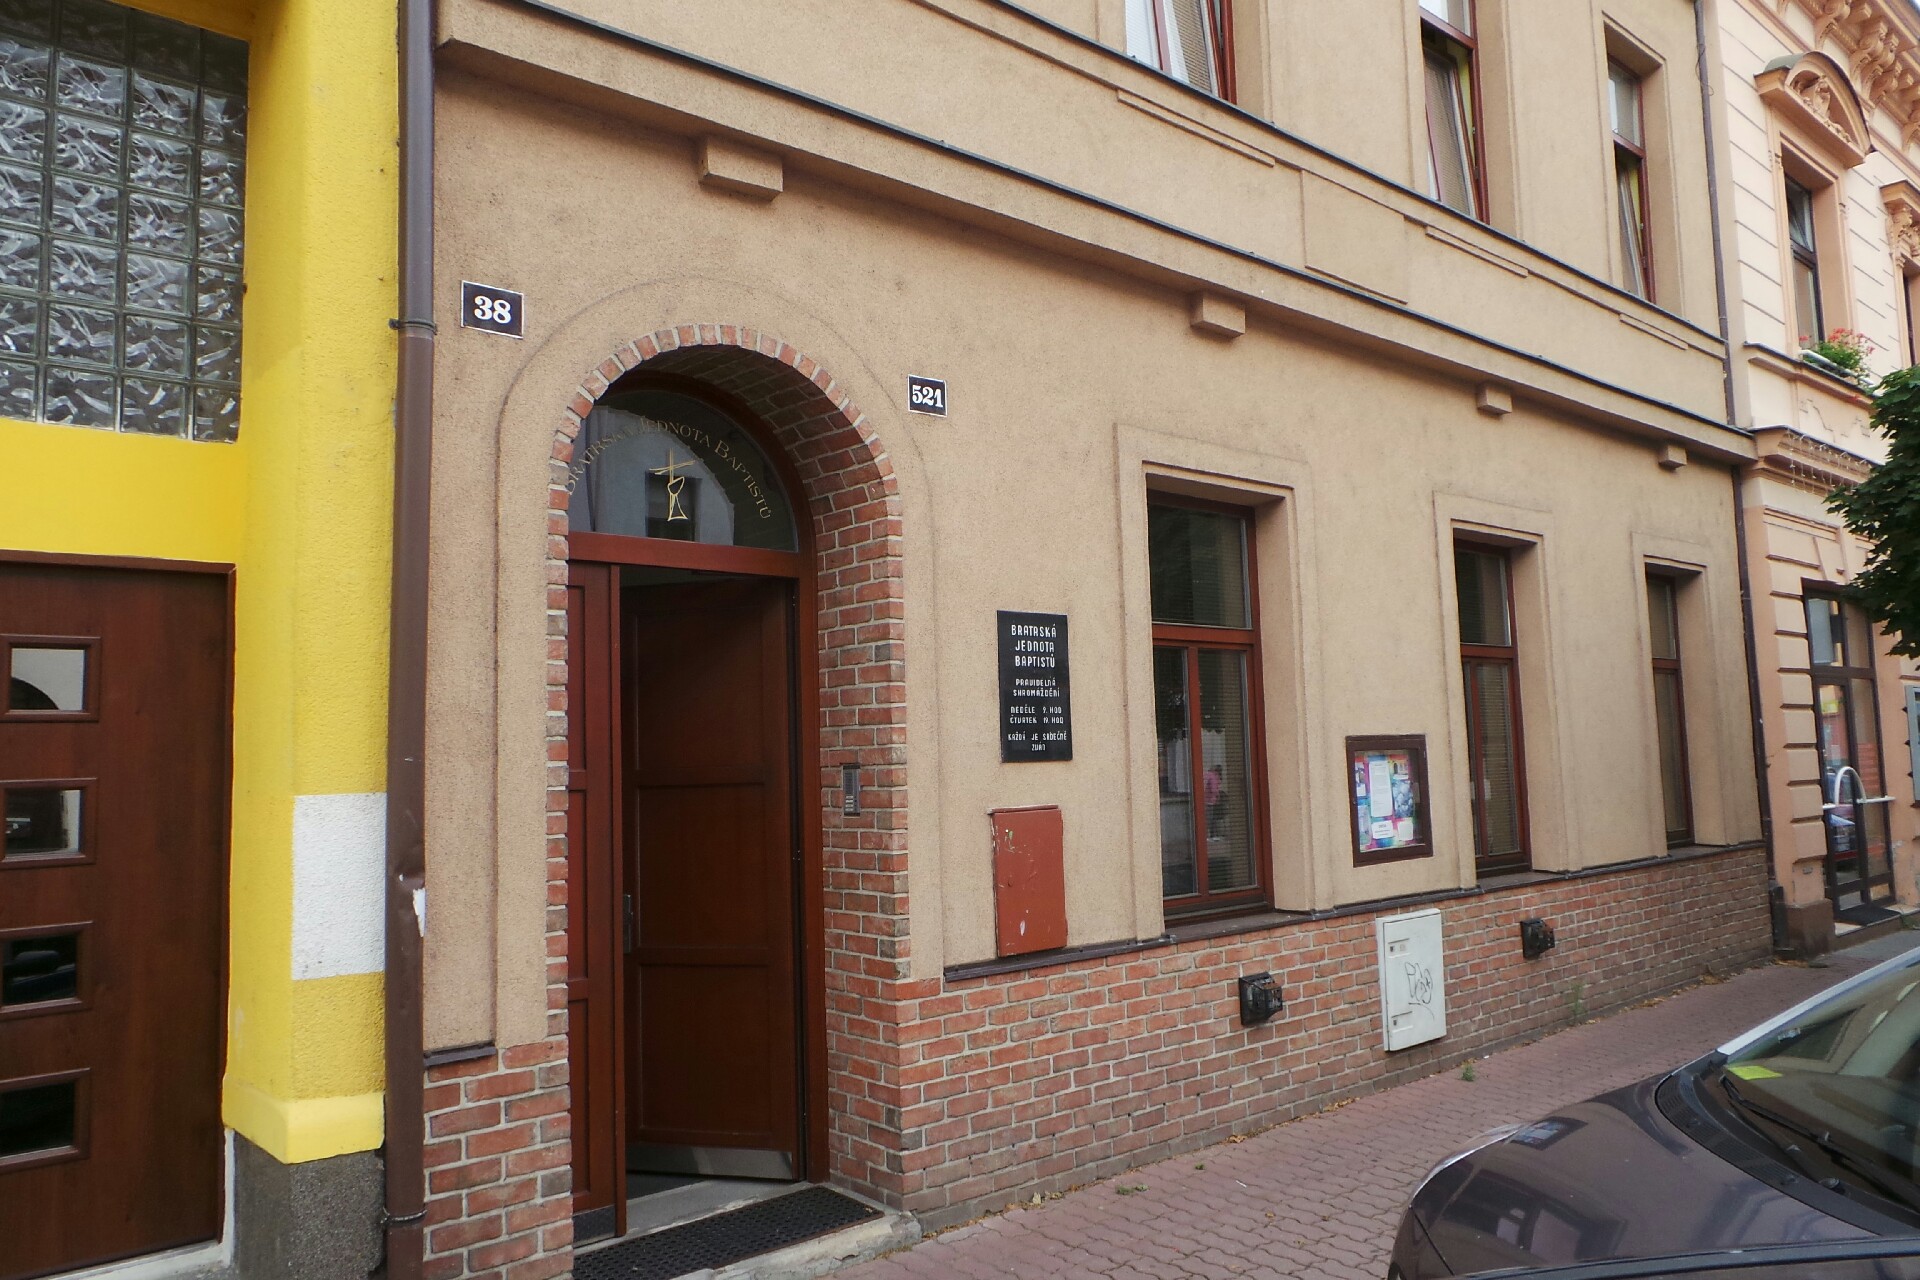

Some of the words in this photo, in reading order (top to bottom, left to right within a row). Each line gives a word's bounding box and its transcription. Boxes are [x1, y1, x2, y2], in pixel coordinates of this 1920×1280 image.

[474, 295, 512, 324] 38
[912, 384, 944, 408] 521
[714, 440, 772, 519] BAPTISTŮ
[1011, 623, 1057, 638] BRATRSKÁ
[1015, 639, 1055, 653] JEDNOTA
[1014, 653, 1056, 668] BAPTISTŮ
[1015, 676, 1056, 687] PRAVIDELNÁ
[1013, 687, 1060, 698] SHROMÁŽDĚNÍ
[1010, 704, 1036, 714] NEDĚLE
[1049, 706, 1062, 714] HOD
[1009, 714, 1038, 724] ČTVRTEK
[1051, 716, 1064, 725] HOD
[1031, 733, 1039, 741] JE
